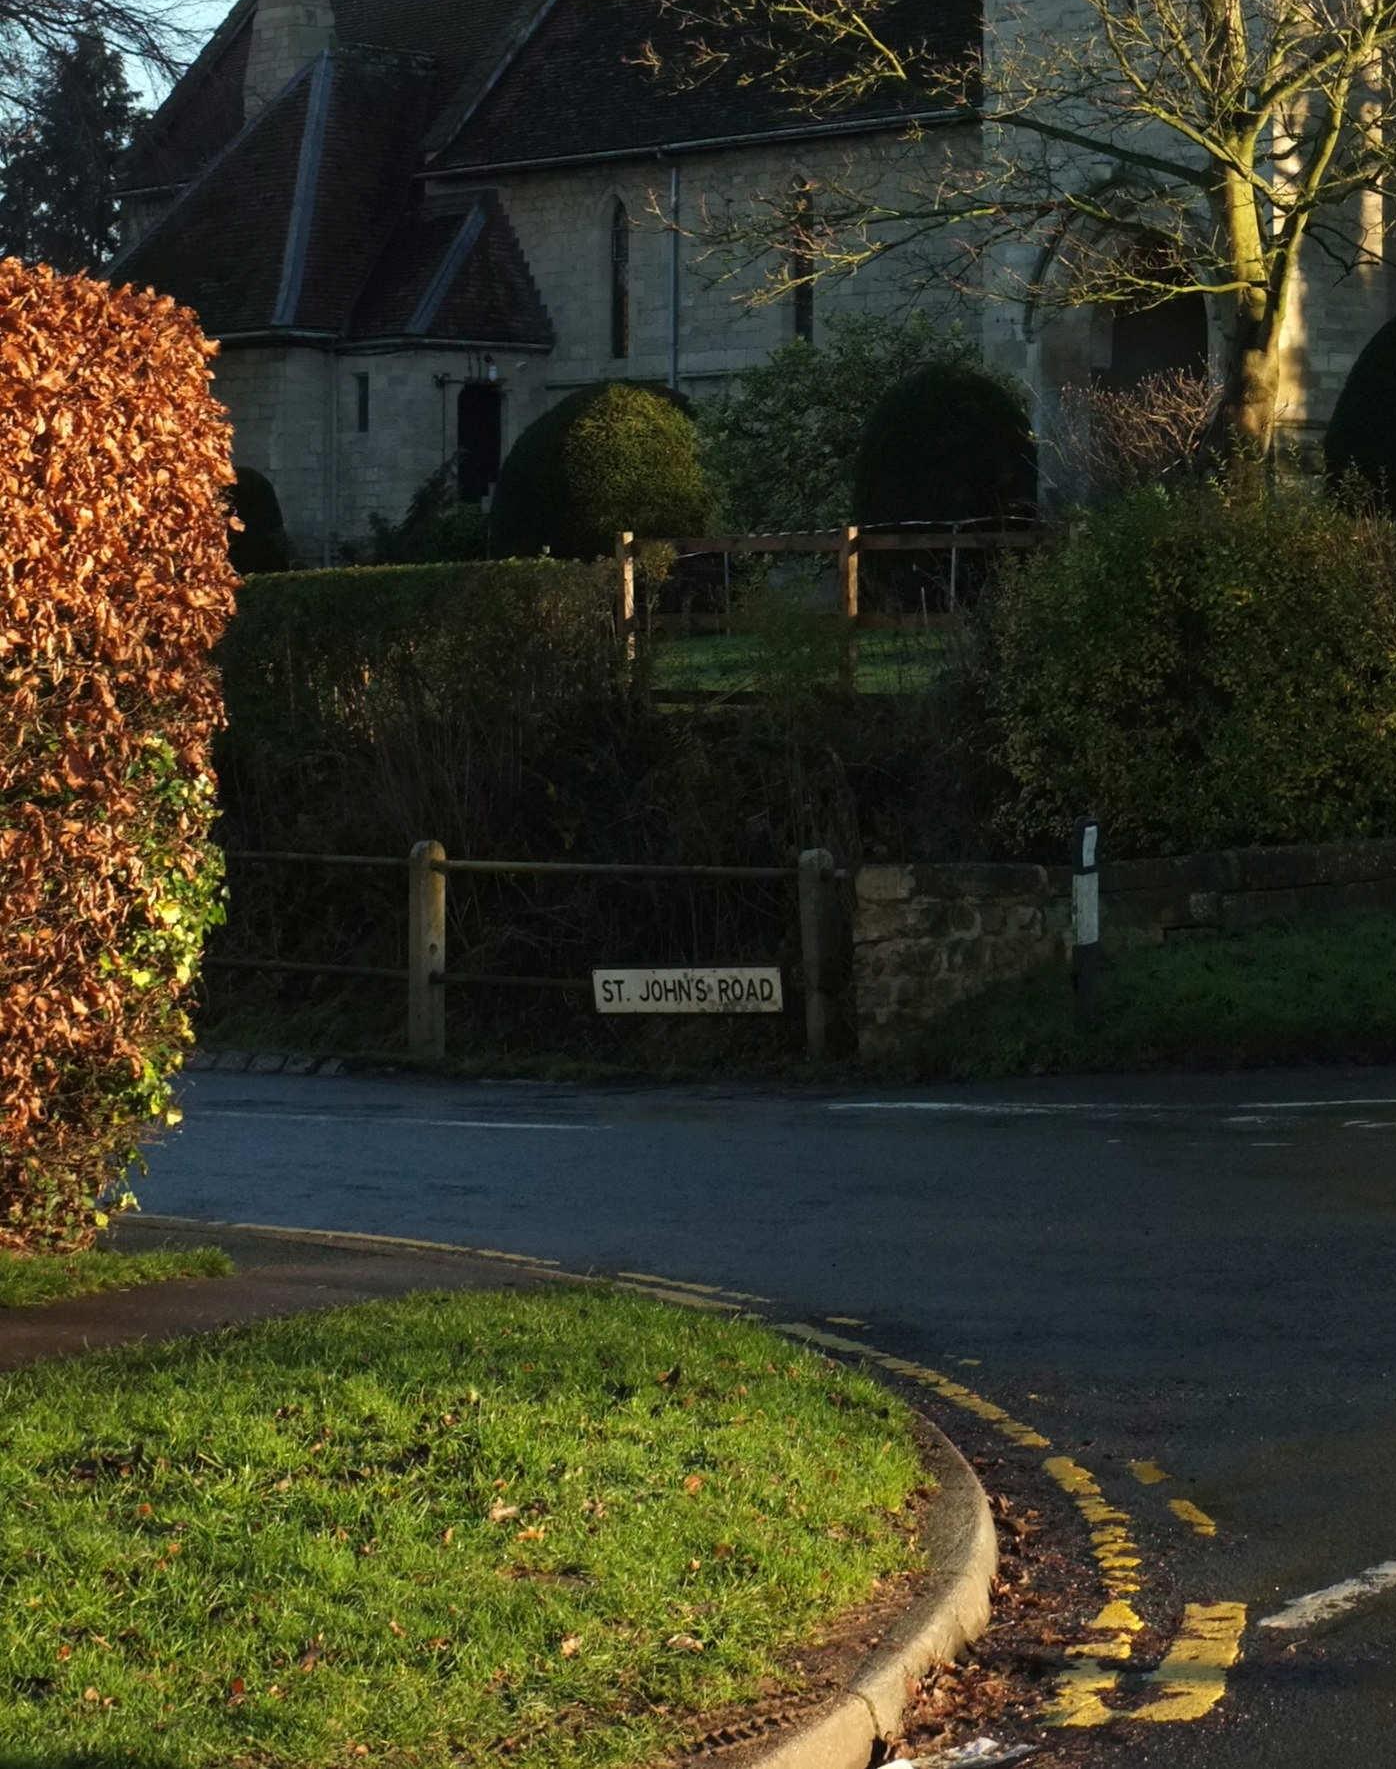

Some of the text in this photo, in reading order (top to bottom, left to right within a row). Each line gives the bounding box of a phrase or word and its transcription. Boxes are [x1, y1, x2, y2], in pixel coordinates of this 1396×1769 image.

[602, 978, 774, 1003] ST. JOHN'S ROAD
